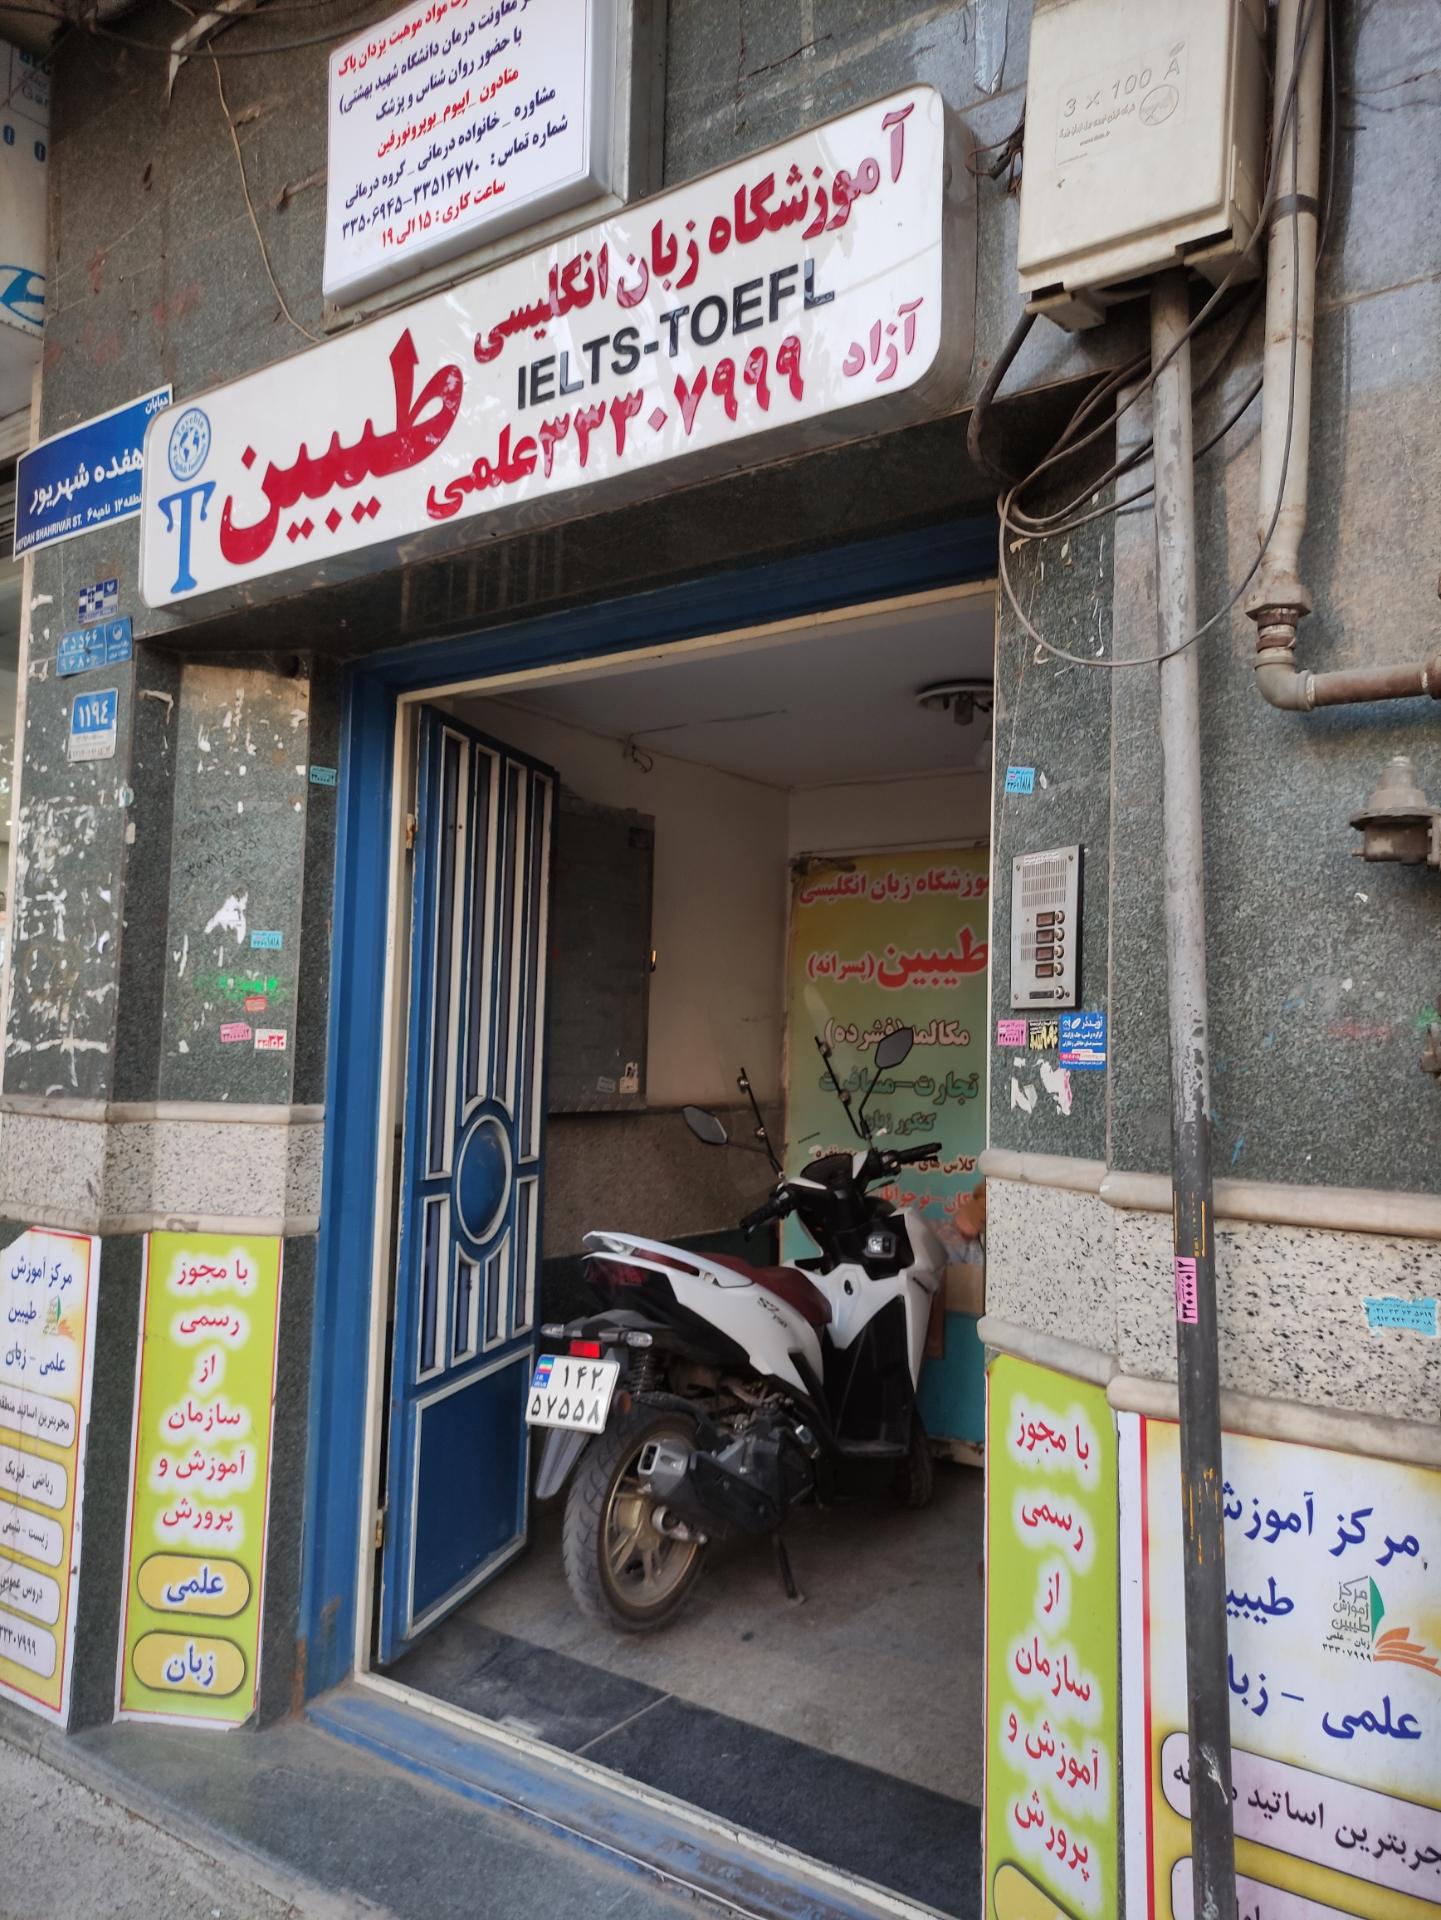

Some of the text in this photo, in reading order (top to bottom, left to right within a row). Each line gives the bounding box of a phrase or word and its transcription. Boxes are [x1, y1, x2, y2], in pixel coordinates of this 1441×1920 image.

[442, 22, 475, 55] درمان
[375, 26, 522, 121] با حضور روان شناس و پزشک
[400, 41, 440, 75] دانشگاه
[375, 62, 399, 93] شهید
[515, 87, 556, 118] مشاوره
[459, 113, 500, 145] خانواده
[533, 115, 568, 146] شماره
[418, 137, 457, 171] درمانی
[382, 160, 406, 189] گروه
[345, 176, 380, 208] درمانی
[474, 179, 506, 207] ساعت
[397, 214, 416, 245] الی
[474, 102, 914, 363] آموزشگاه زبان انگلیسی
[516, 256, 836, 410] IELTS-TOEFL
[842, 296, 924, 383] آزاد
[219, 327, 465, 566] طیبین
[94, 447, 144, 484] هفده
[426, 422, 538, 519] علمی
[29, 462, 90, 516] شهریور
[800, 870, 867, 904] انگلیسی
[871, 868, 912, 901] زبان
[877, 927, 990, 988] طیبین
[913, 1018, 970, 1047] مکالم
[943, 1157, 976, 1174] کلاس
[10, 1256, 73, 1291] مرکز آموزش
[176, 1255, 249, 1286] با مجوز
[7, 1300, 38, 1325] طیبین
[179, 1311, 241, 1336] رسمی
[5, 1341, 27, 1370] زبان
[39, 1351, 66, 1376] علمی
[199, 1354, 216, 1382] از
[563, 1364, 604, 1391] ۱۴۲
[167, 1401, 241, 1433] سازمان
[530, 1393, 600, 1426] ۵۷۵۵۸
[1016, 1412, 1090, 1470] با مجوز
[158, 1447, 246, 1480] آموزش و
[161, 1496, 234, 1533] پرورش
[1021, 1503, 1085, 1552] رسمی
[1328, 1506, 1421, 1568] مرکز
[165, 1565, 225, 1603] علمی
[1042, 1571, 1061, 1614] از
[1226, 1576, 1295, 1625] طیبی
[165, 1644, 217, 1685] زبان
[1015, 1636, 1091, 1702] سازمان
[1227, 1653, 1270, 1718] زبا
[1321, 1694, 1423, 1741] علمی
[1007, 1712, 1100, 1791] آموزش و
[1014, 1789, 1091, 1883] پرورش
[1247, 1783, 1441, 1876] جربترین اساتید
